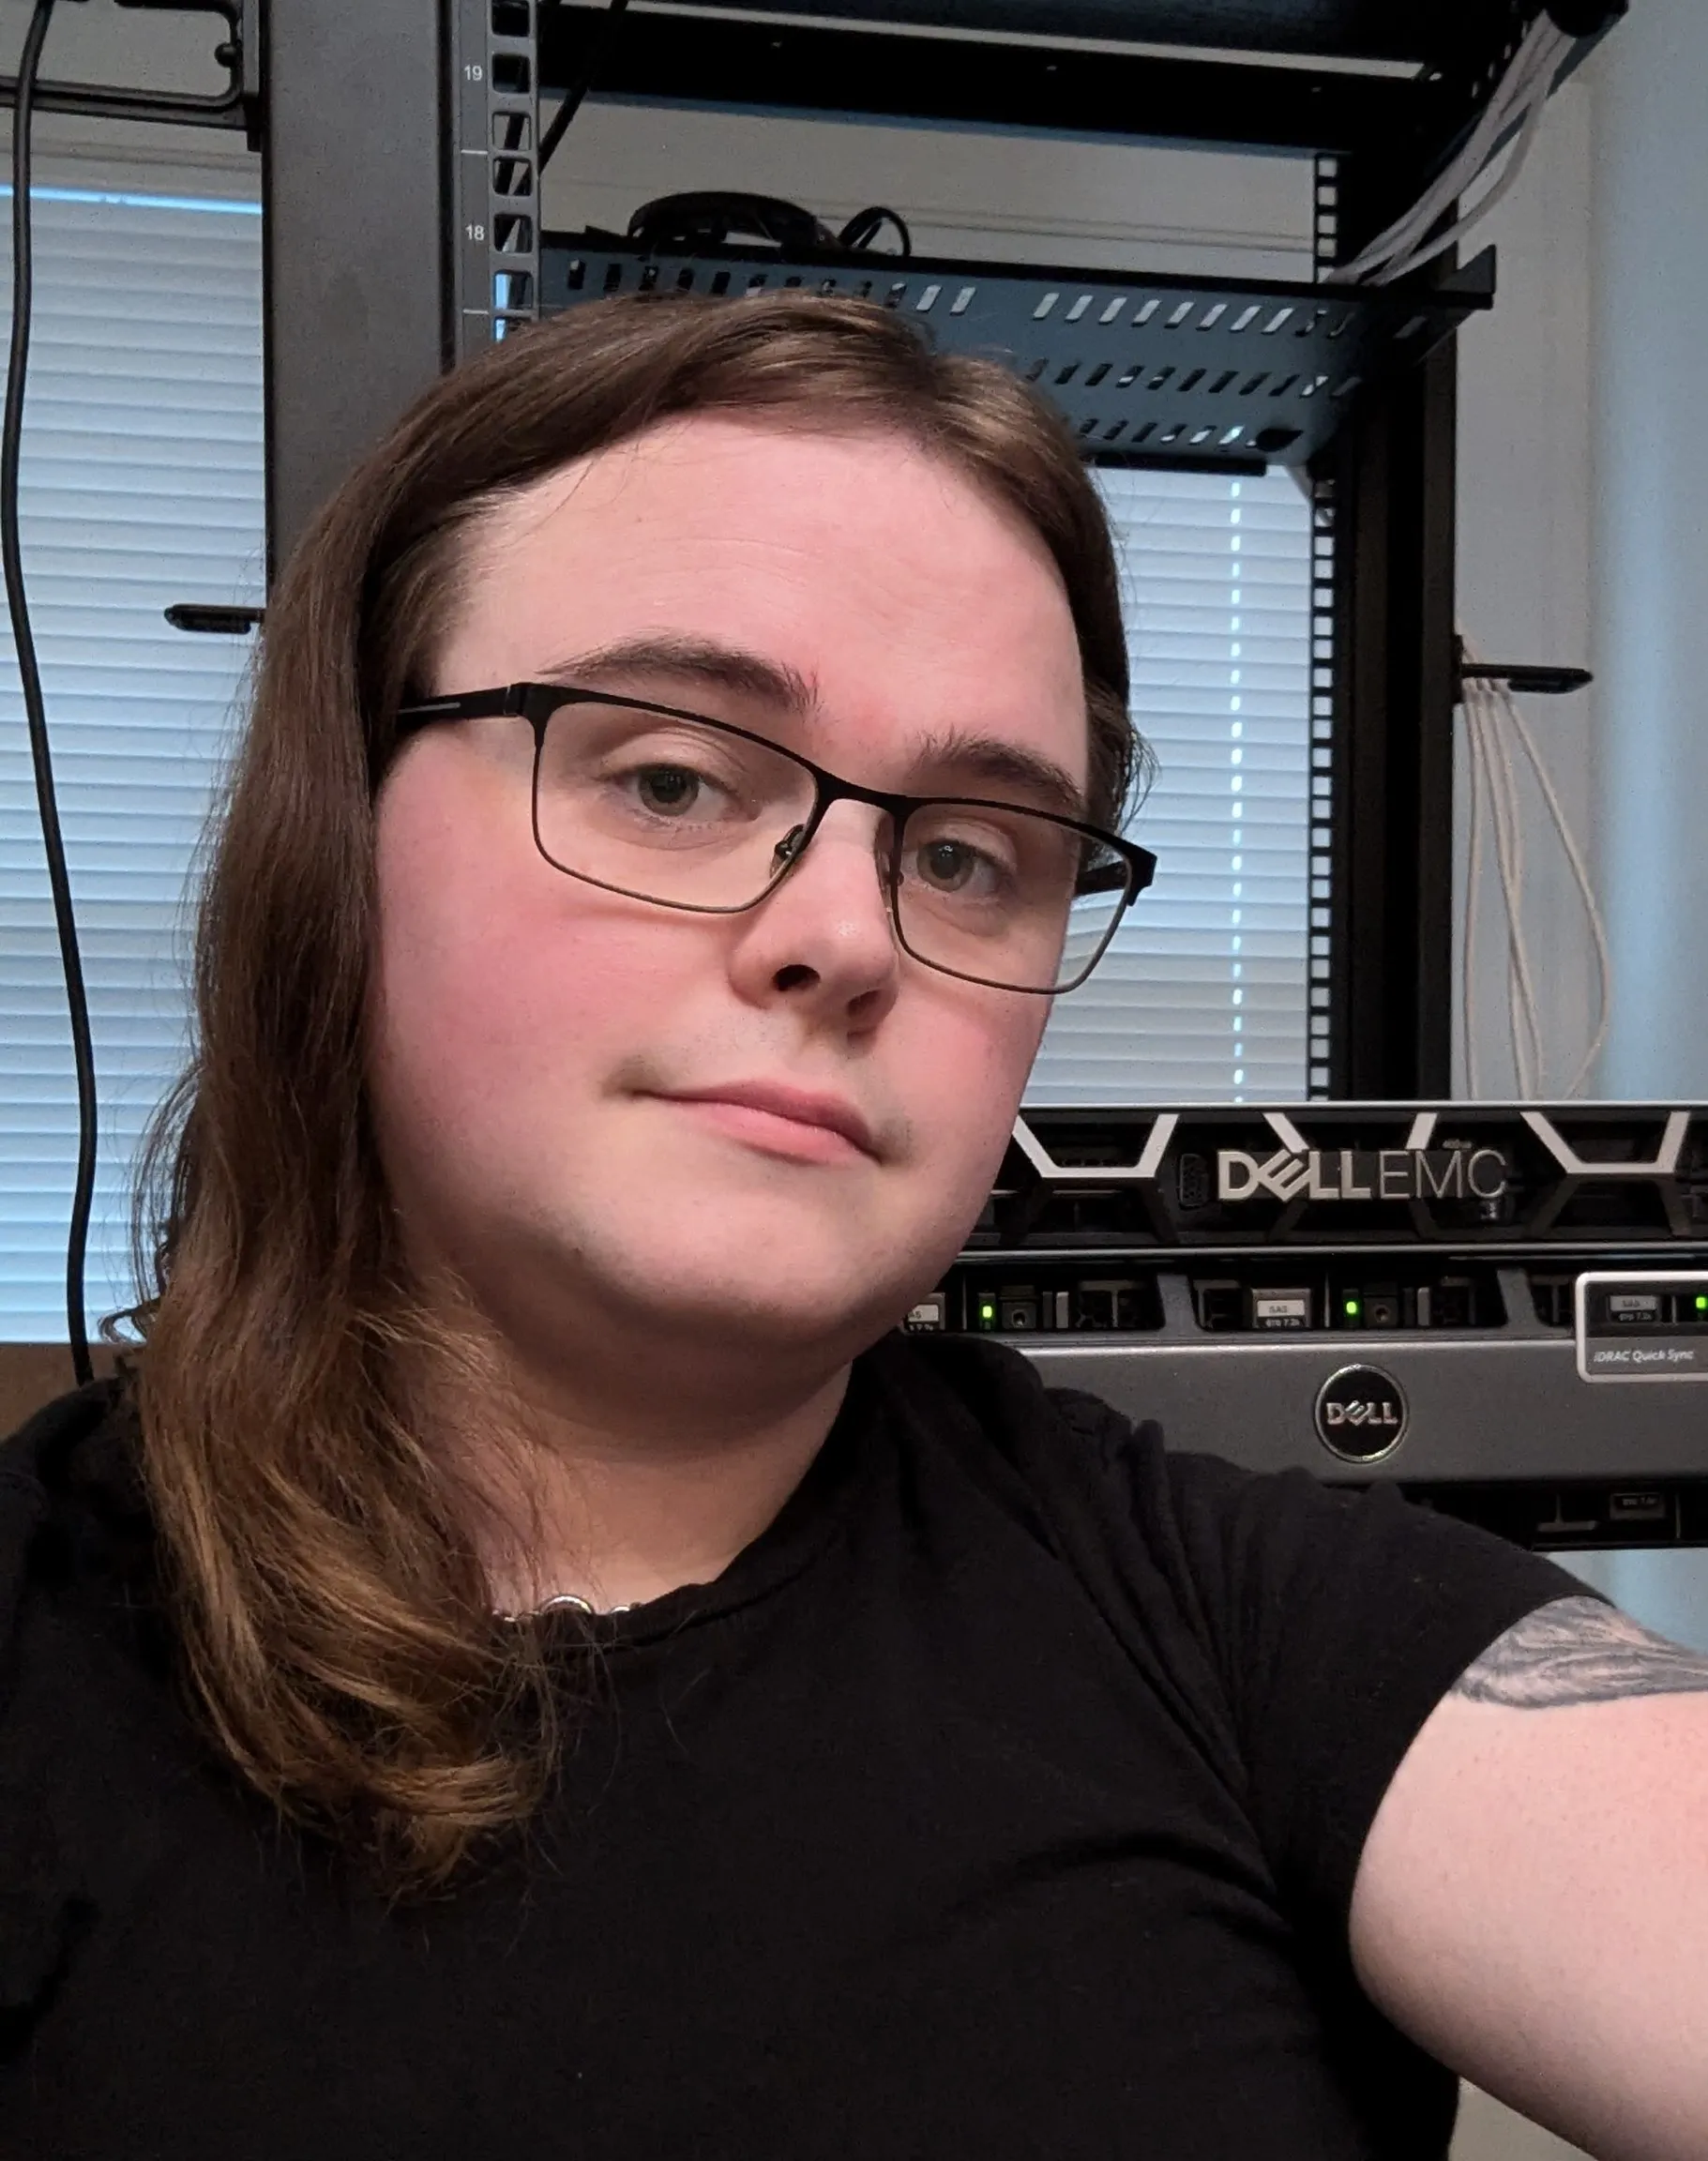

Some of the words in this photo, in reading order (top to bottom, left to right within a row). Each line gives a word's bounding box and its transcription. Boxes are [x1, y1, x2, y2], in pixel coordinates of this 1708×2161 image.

[463, 64, 483, 81] 19
[465, 224, 485, 241] 18
[1218, 1149, 1371, 1202] DELL
[1379, 1149, 1506, 1199] EMC
[1632, 1351, 1666, 1363] Quick
[1667, 1349, 1695, 1363] Sync
[1326, 1400, 1398, 1426] DELL
